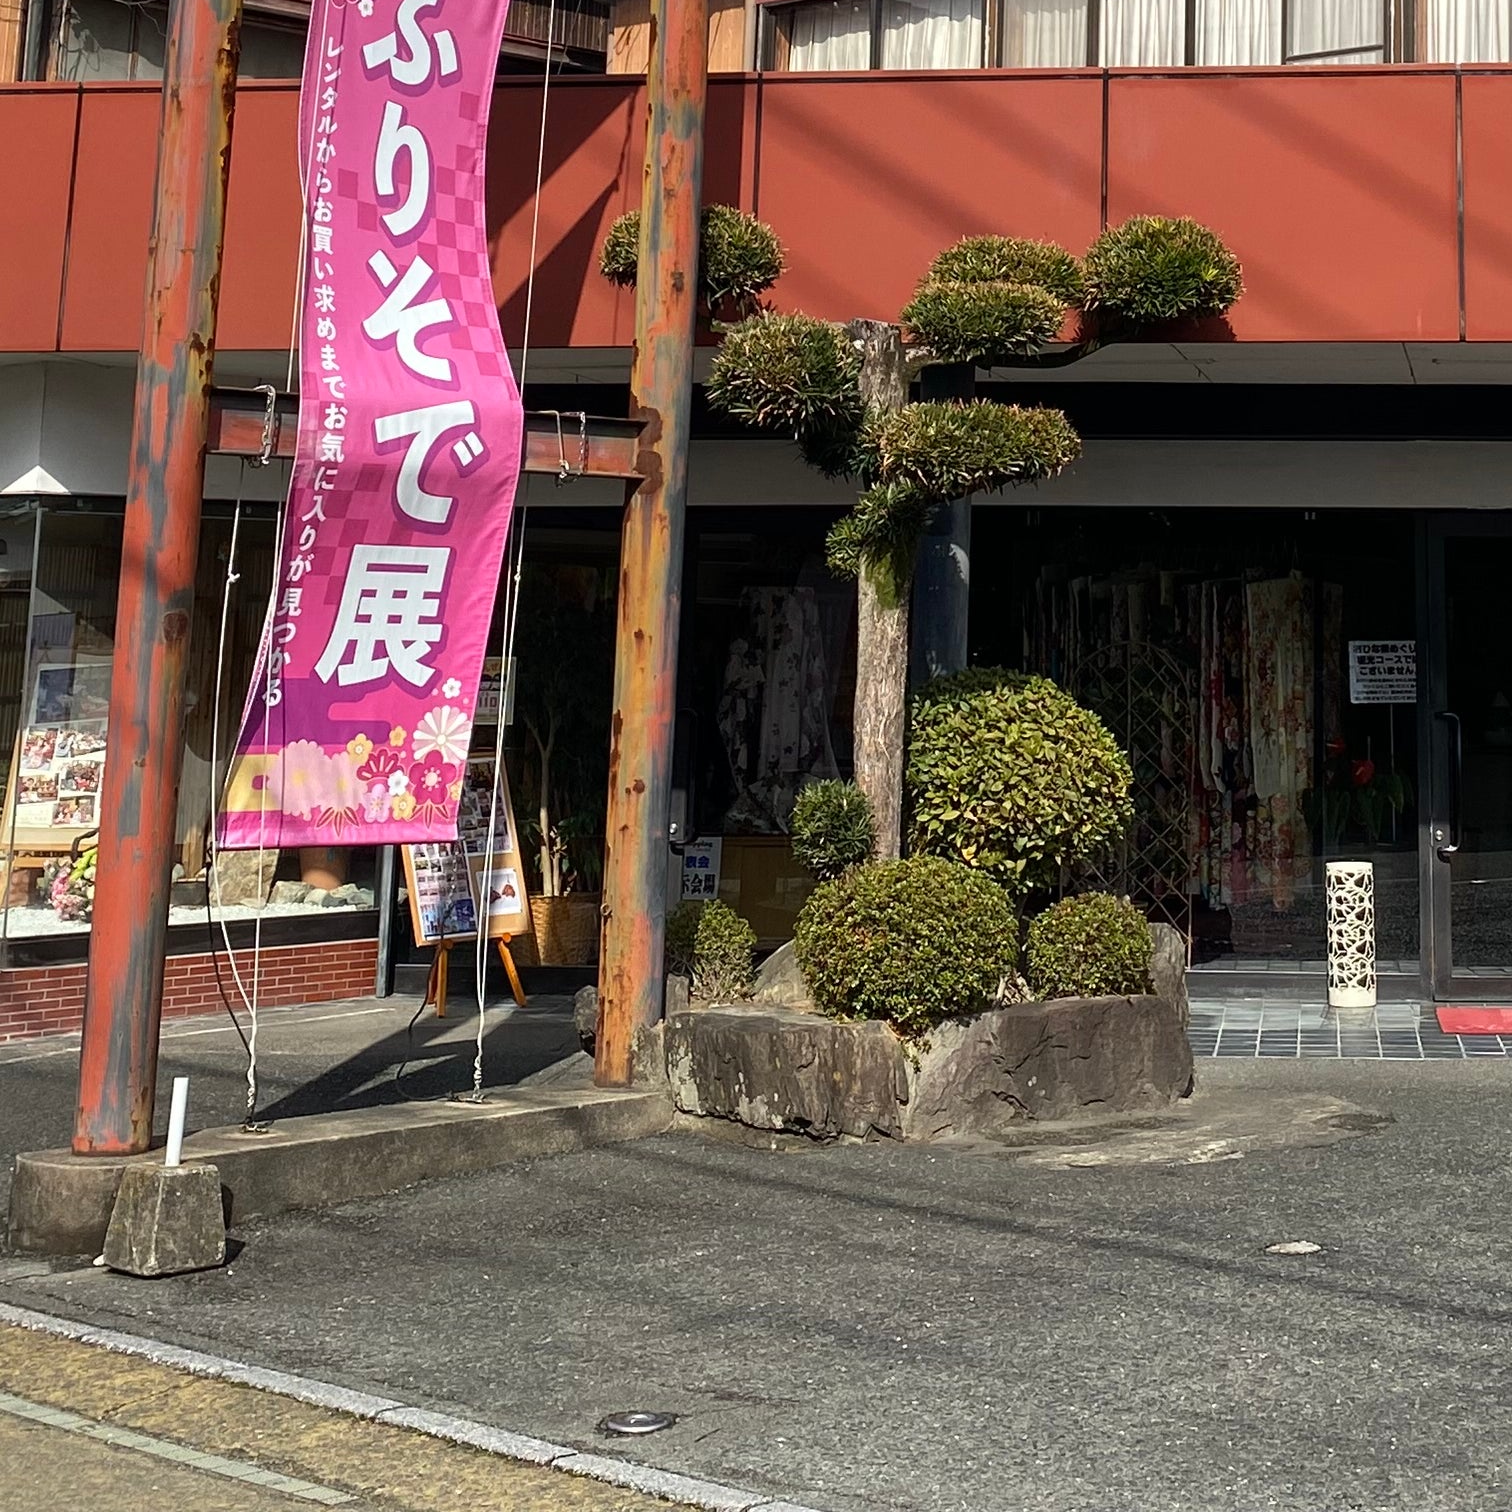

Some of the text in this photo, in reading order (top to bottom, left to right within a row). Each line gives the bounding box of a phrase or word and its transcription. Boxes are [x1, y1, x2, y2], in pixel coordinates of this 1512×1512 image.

[262, 37, 347, 708] レンタルからお買い求めまでお気に入りが見つかる
